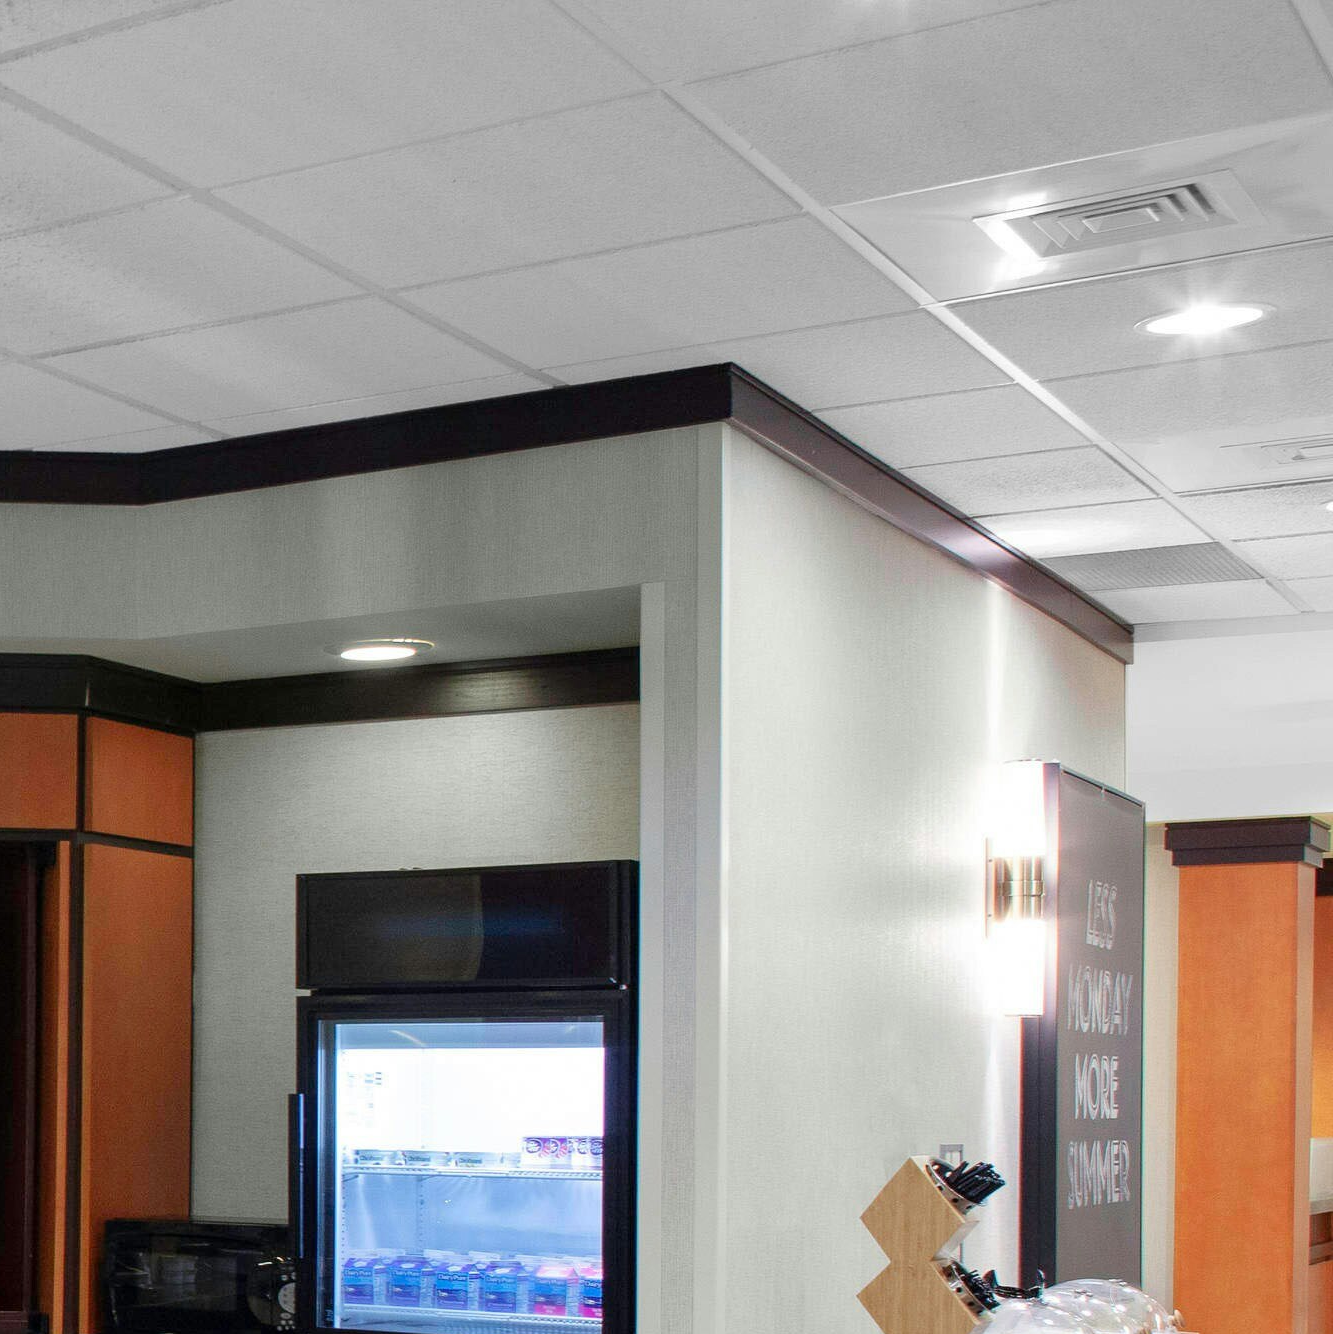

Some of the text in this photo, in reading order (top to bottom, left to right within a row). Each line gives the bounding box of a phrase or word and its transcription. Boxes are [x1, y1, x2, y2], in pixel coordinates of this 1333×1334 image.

[1086, 879, 1118, 950] LESS
[1067, 962, 1133, 1036] MONDAY
[1074, 1053, 1120, 1121] MORE
[1067, 1139, 1131, 1210] SUMMER
